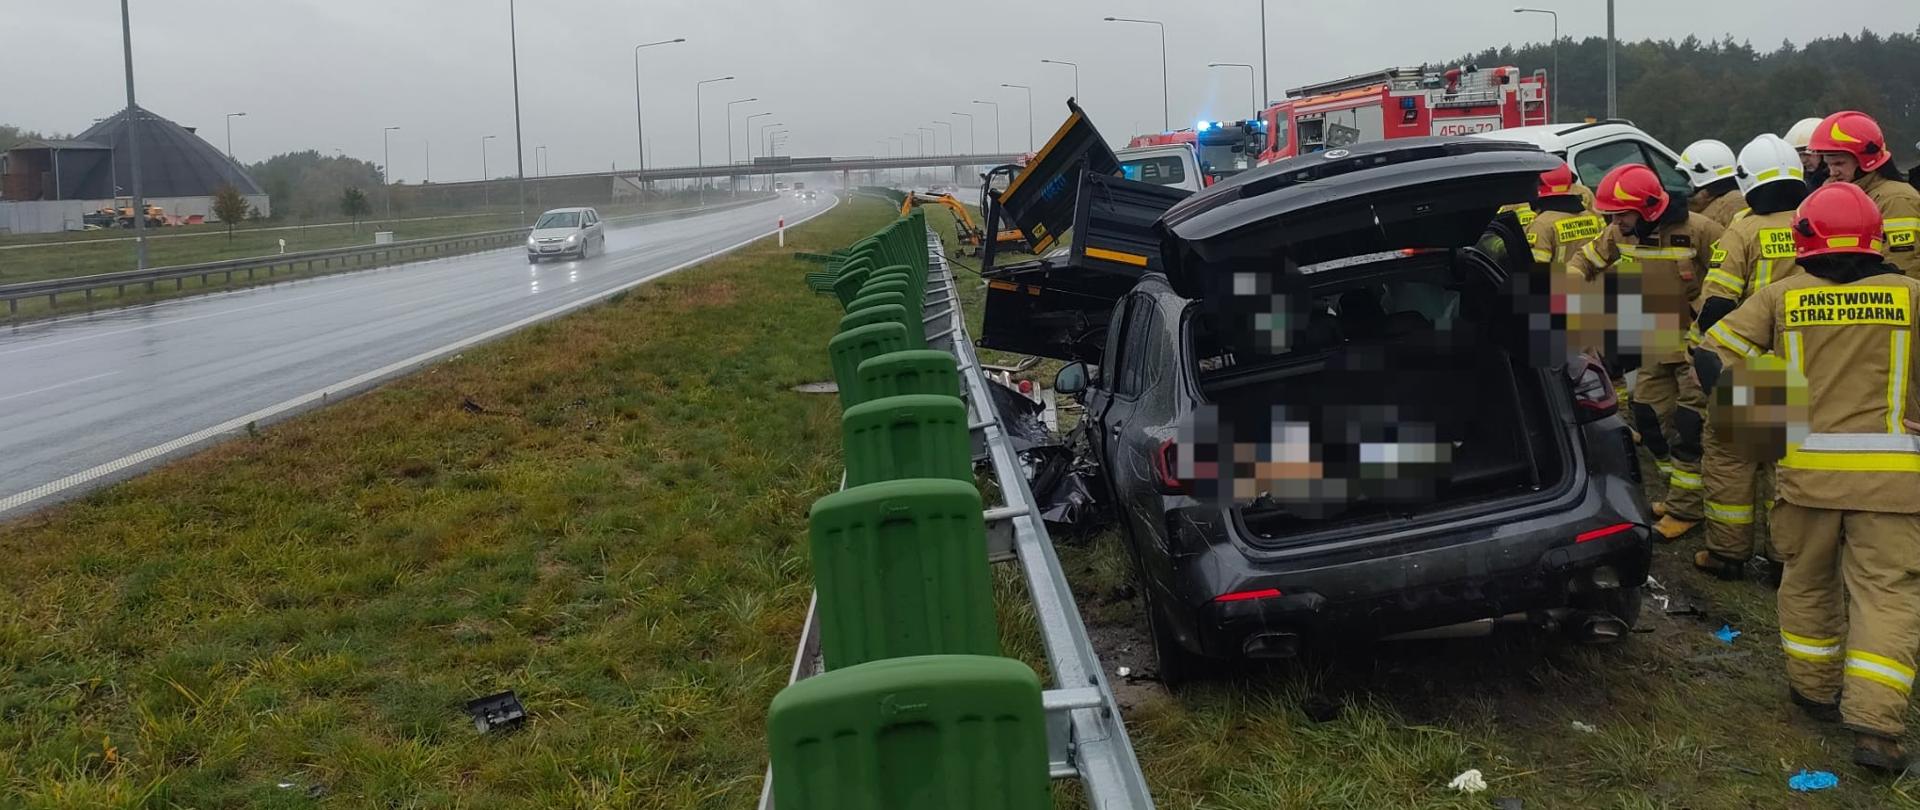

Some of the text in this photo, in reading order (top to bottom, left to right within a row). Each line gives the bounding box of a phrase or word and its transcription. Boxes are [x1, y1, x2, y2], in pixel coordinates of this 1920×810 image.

[1770, 232, 1791, 243] OCH
[1892, 232, 1911, 243] PSP
[1800, 291, 1894, 307] PAŃSTWOWA
